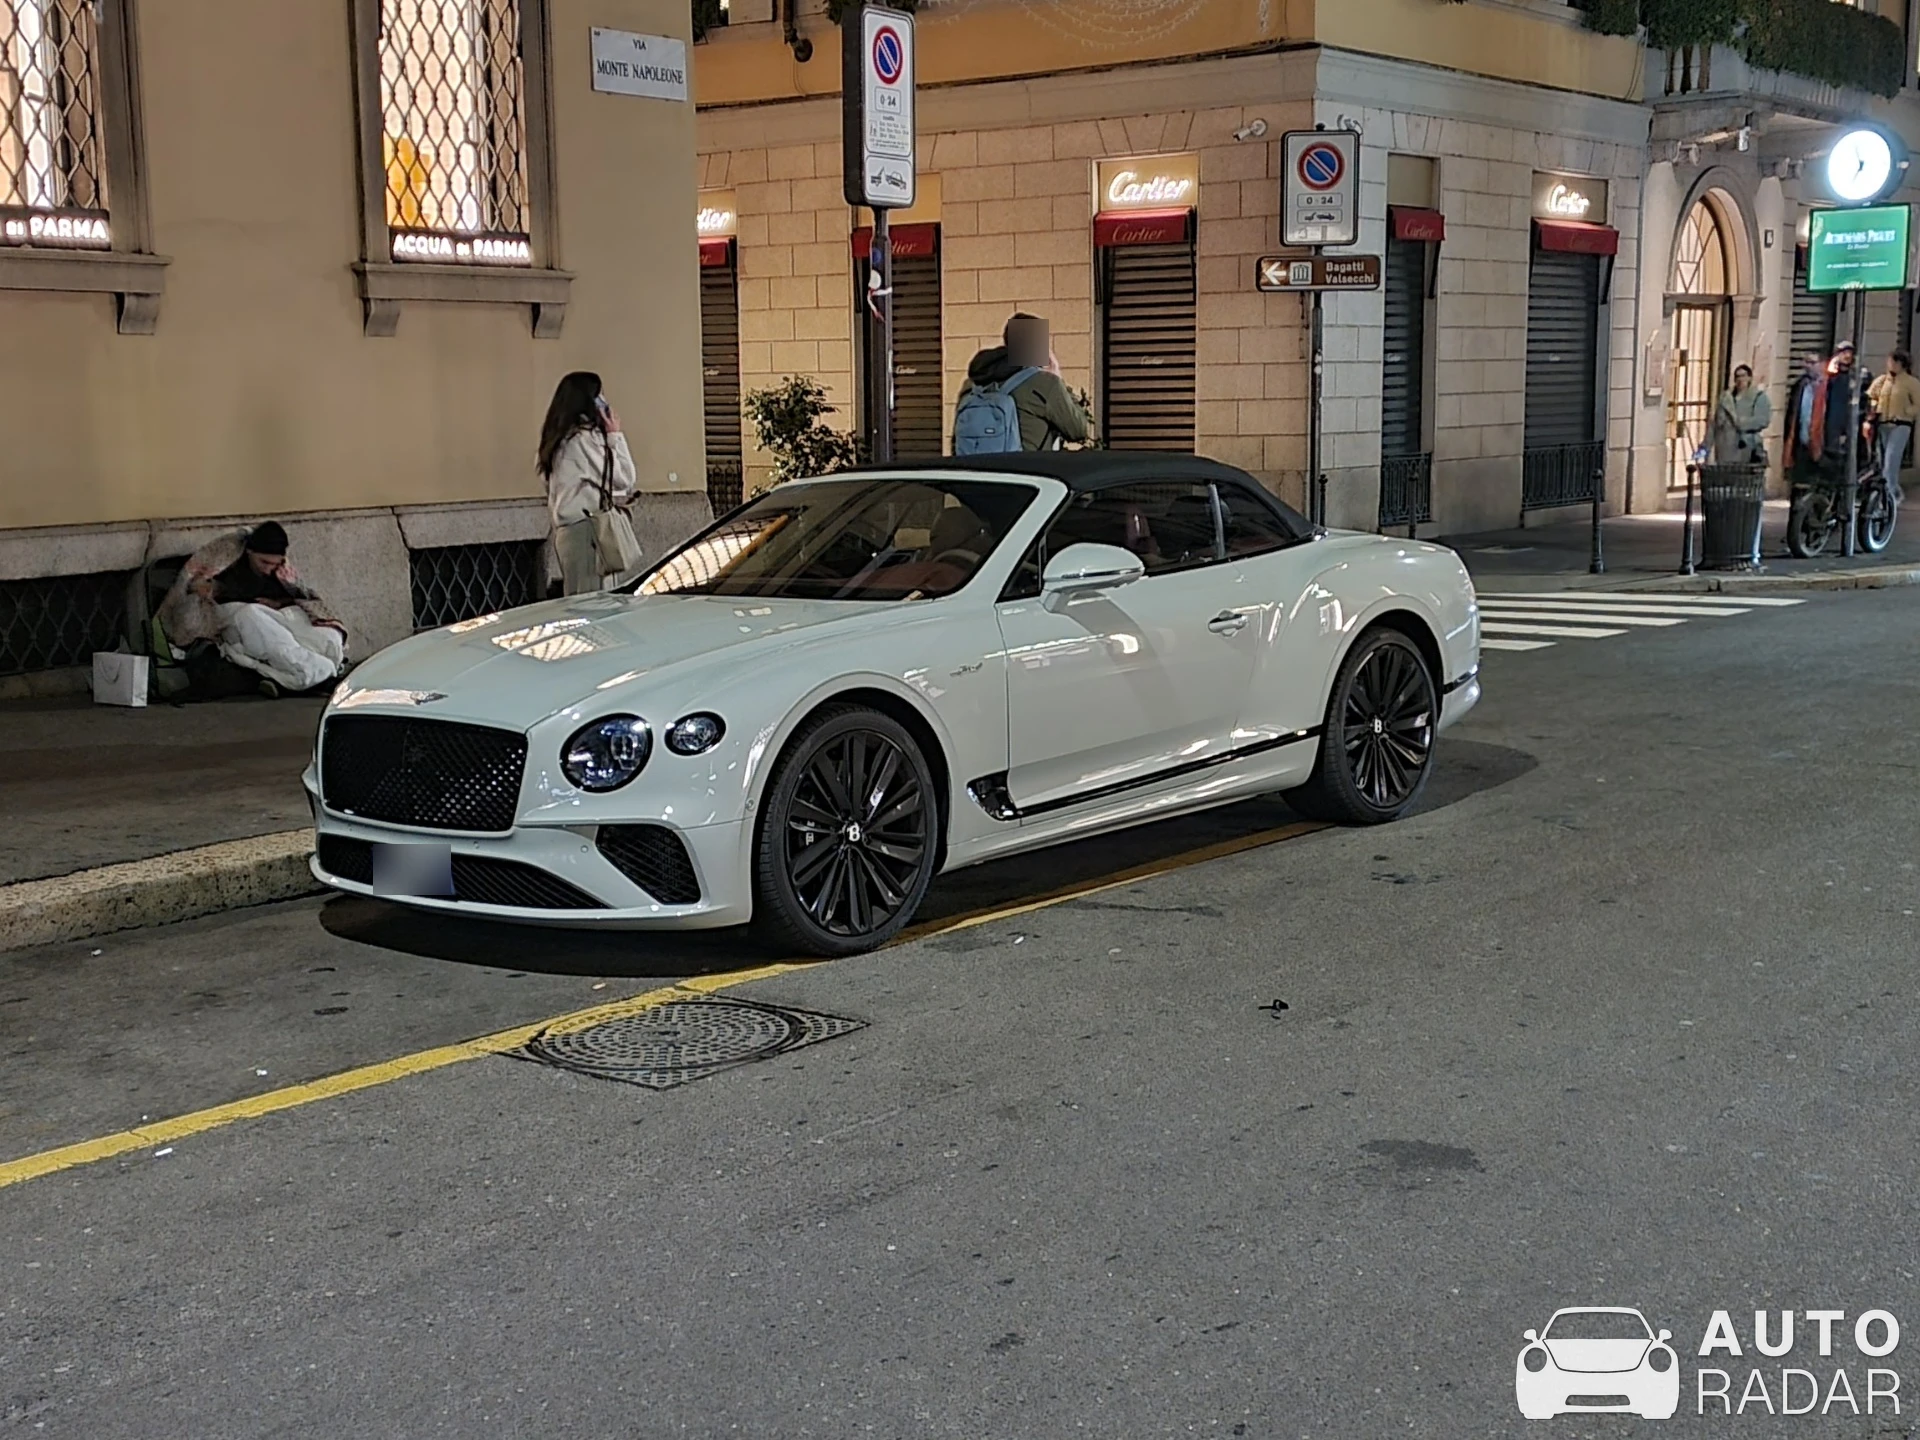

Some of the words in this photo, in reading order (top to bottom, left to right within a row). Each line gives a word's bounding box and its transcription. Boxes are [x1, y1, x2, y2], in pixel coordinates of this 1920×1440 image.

[633, 39, 646, 50] VIA
[597, 59, 629, 77] MONTE
[632, 63, 684, 84] NAPOLEONE
[1108, 171, 1191, 202] Cartier
[5, 220, 24, 236] DI
[30, 216, 107, 239] PARMA
[697, 208, 731, 230] tier
[1112, 223, 1165, 242] Cartier
[393, 234, 453, 254] ACQUA
[473, 238, 529, 258] PARMA
[892, 240, 918, 254] tier
[1326, 261, 1365, 273] Bagatti
[1326, 272, 1375, 284] Valsecchi
